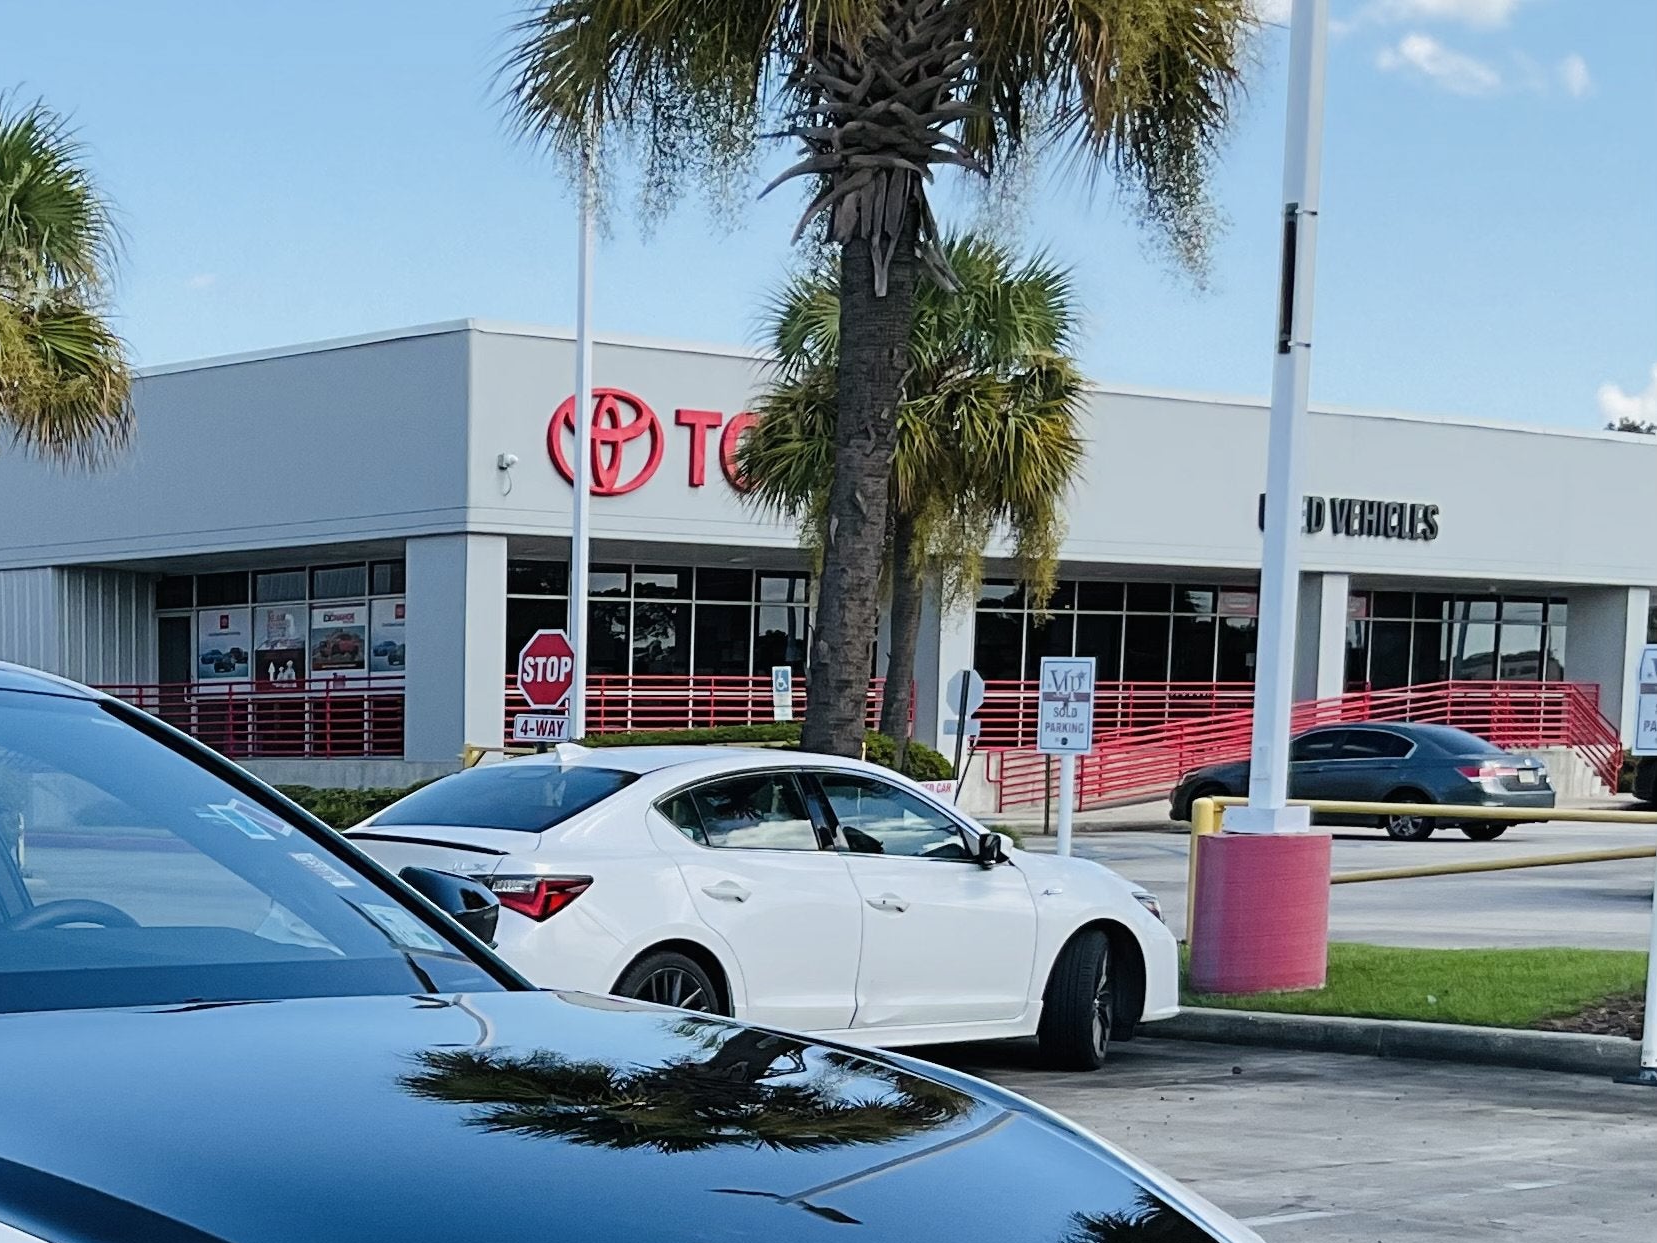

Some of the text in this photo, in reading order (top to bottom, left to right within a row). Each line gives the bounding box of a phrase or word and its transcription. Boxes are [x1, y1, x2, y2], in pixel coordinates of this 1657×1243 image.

[1329, 497, 1440, 541] VEHICLES
[523, 656, 572, 682] STOP
[1053, 707, 1078, 718] SOLD
[520, 720, 564, 738] 4-WAY
[1045, 722, 1084, 734] PARKING
[936, 782, 952, 793] CAR
